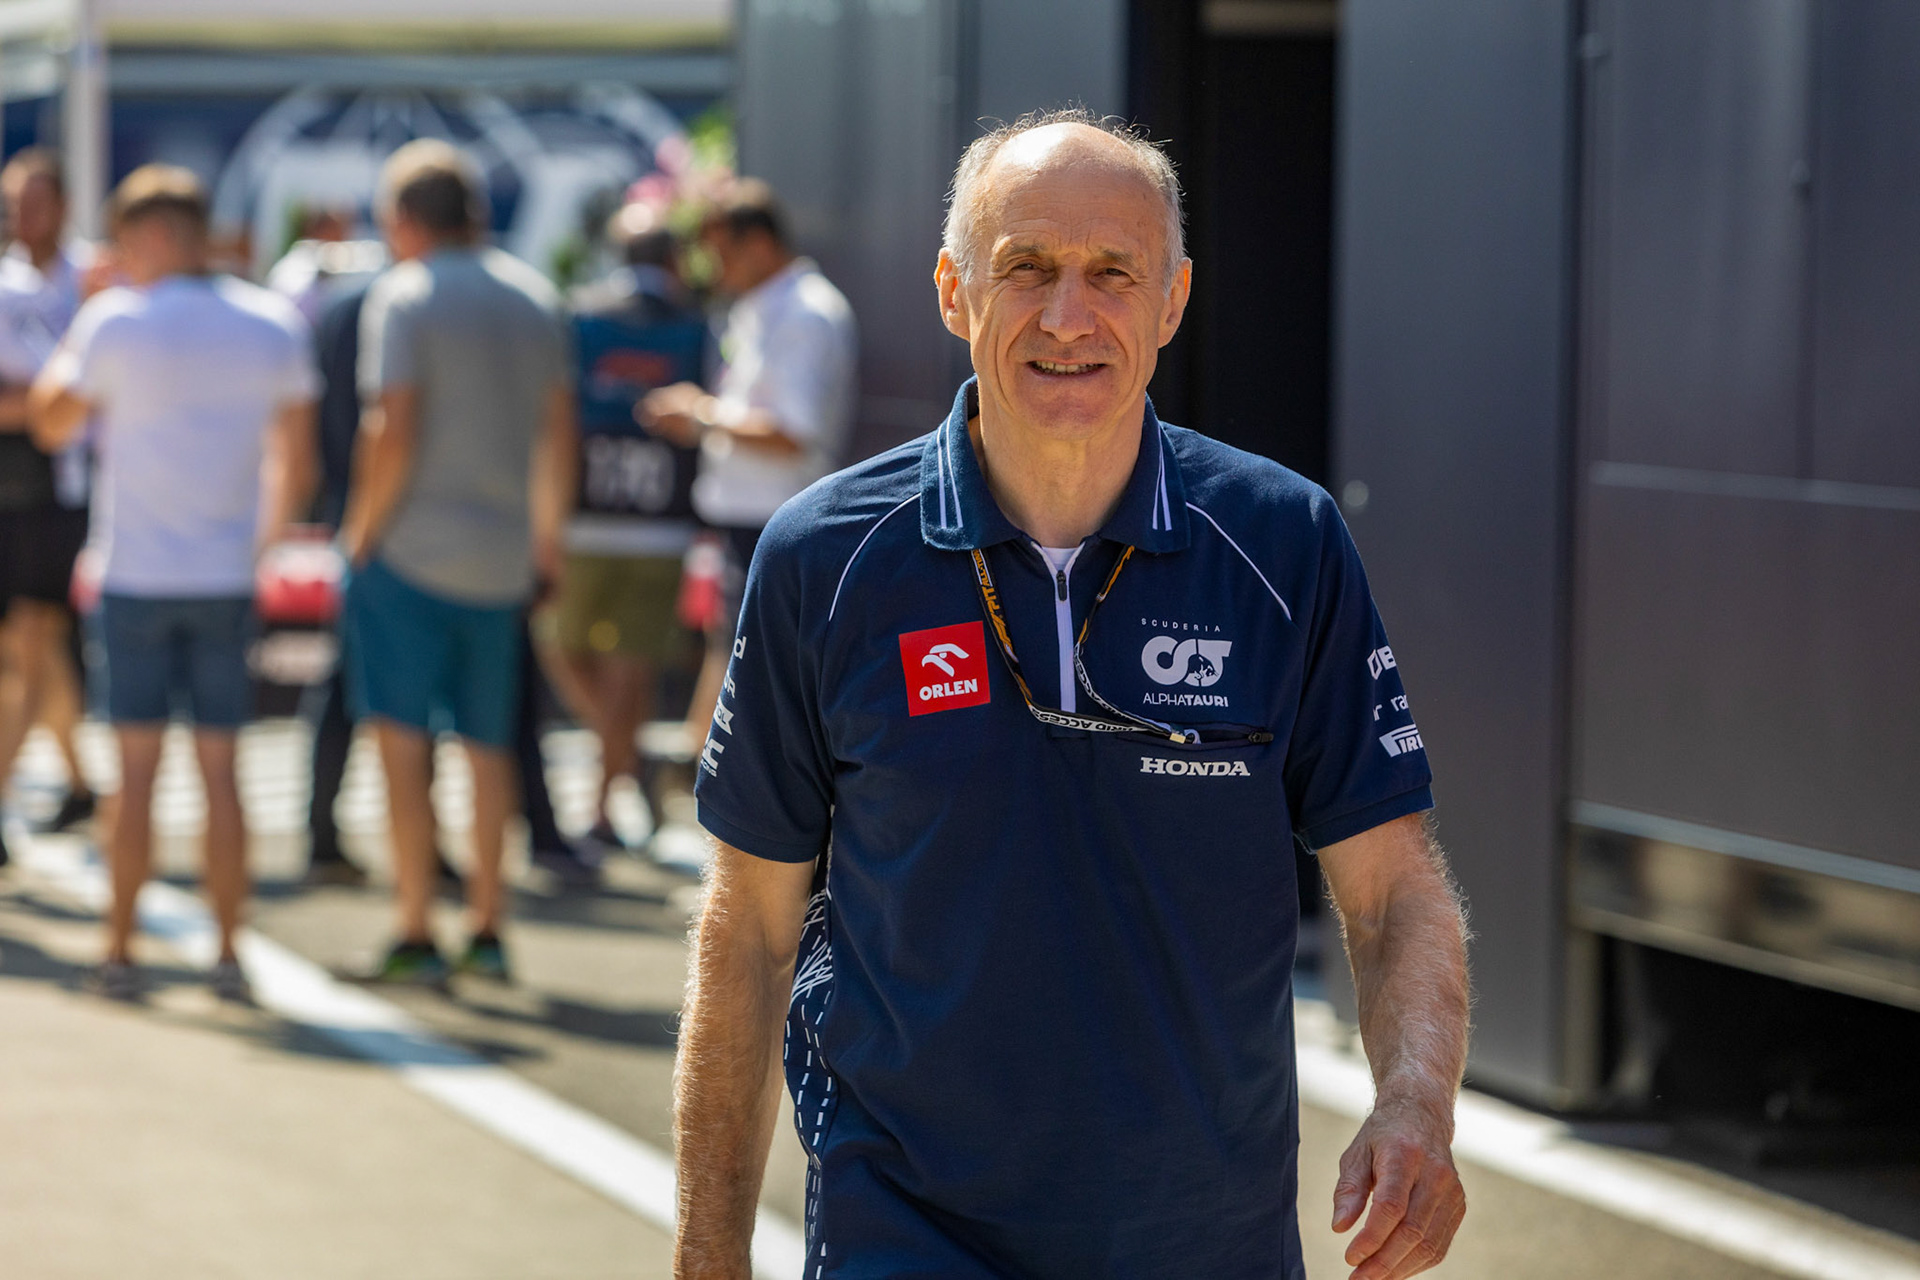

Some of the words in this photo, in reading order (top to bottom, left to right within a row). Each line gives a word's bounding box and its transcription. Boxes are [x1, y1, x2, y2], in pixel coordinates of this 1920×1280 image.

[1141, 618, 1221, 633] SCUDERIA
[919, 678, 978, 701] ORLEN
[1143, 692, 1229, 708] ALPHATAURI
[1140, 756, 1251, 777] HONDA
